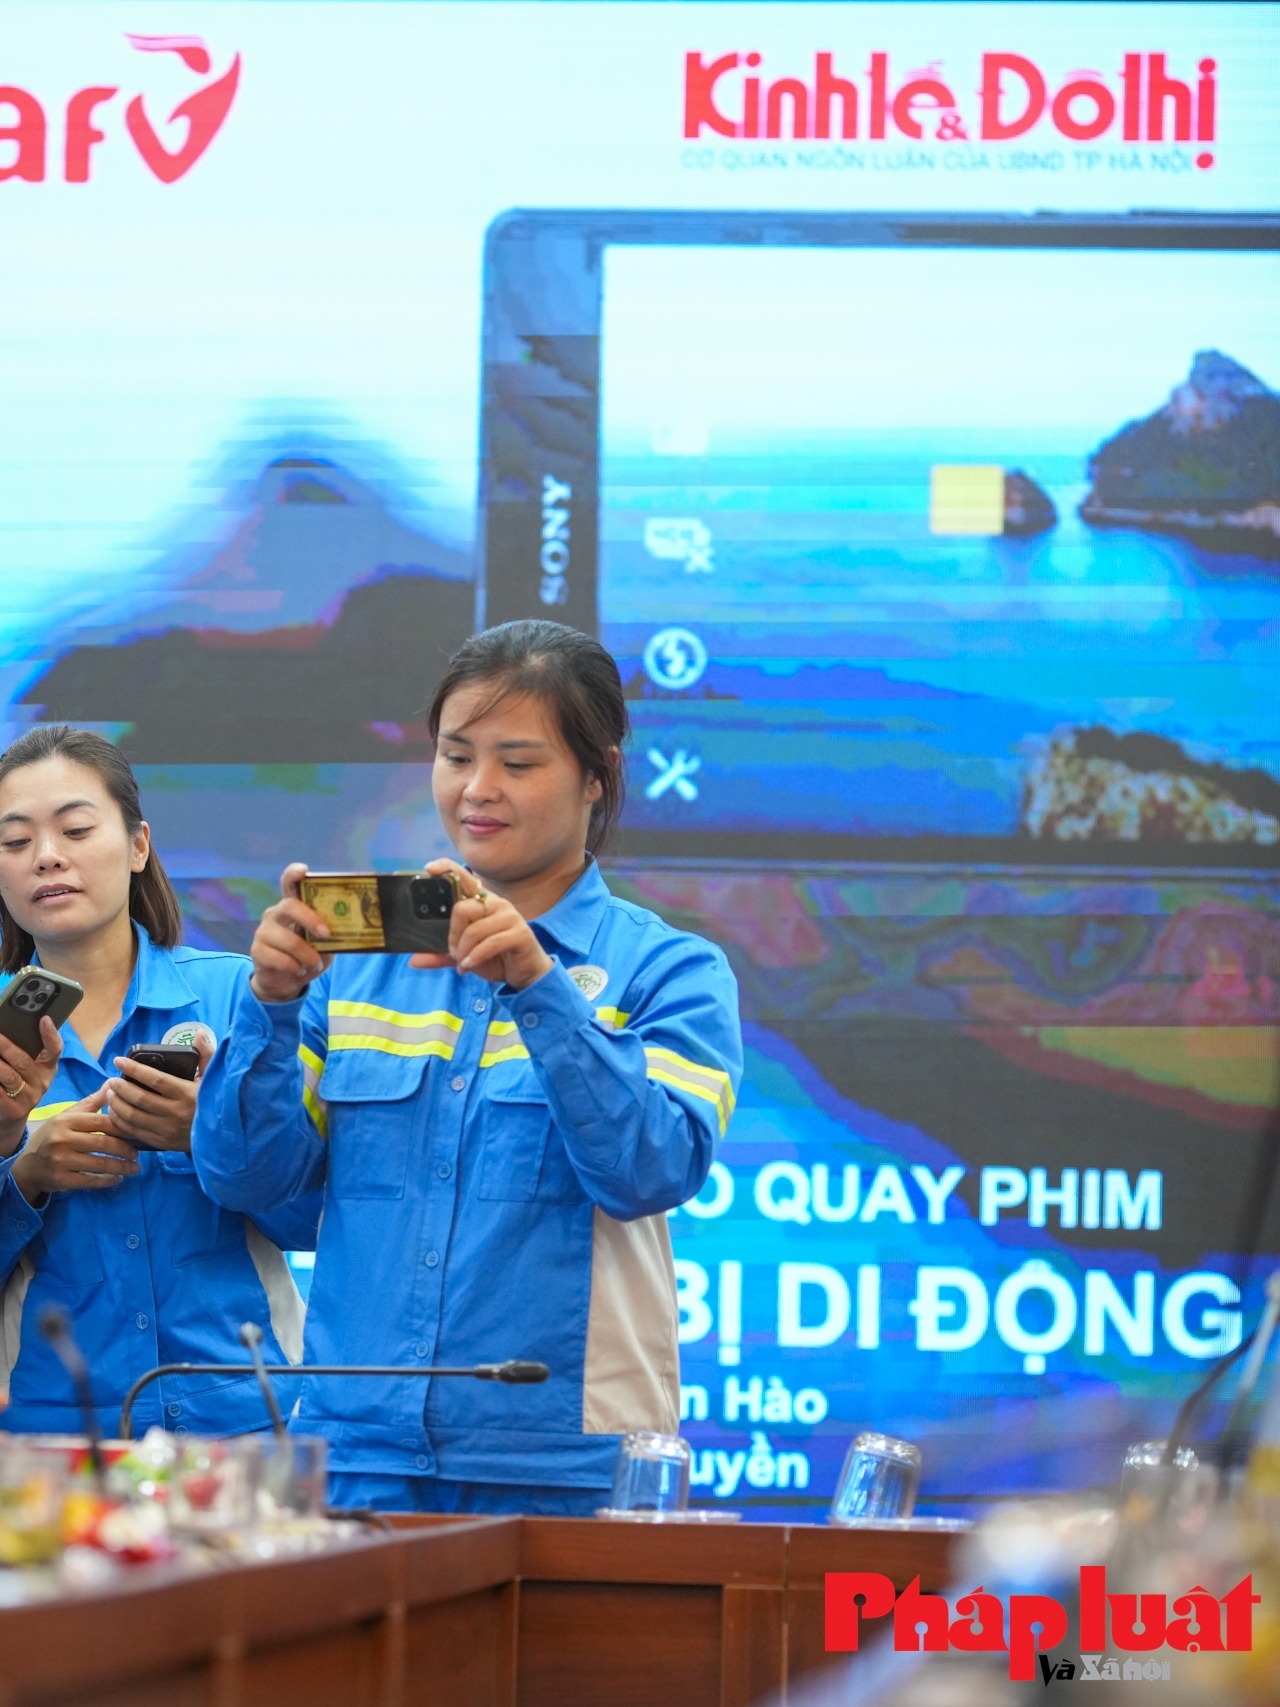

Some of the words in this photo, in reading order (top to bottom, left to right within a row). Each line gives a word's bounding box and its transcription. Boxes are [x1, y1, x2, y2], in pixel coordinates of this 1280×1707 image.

[721, 147, 788, 171] QUAN
[796, 145, 865, 170] NGÔN
[998, 148, 1065, 171] UBND
[1072, 148, 1103, 171] TP
[1109, 146, 1144, 171] HÀ
[936, 114, 969, 141] &
[540, 473, 571, 605] SONY
[666, 1160, 734, 1219] O
[754, 1160, 965, 1226] QUAY
[980, 1165, 1163, 1230] PHIM
[673, 1259, 742, 1366] BỊ
[778, 1261, 881, 1350] DI
[908, 1258, 1243, 1375] ĐỘNG
[724, 1374, 829, 1424] Hào
[689, 1430, 811, 1497] uyền
